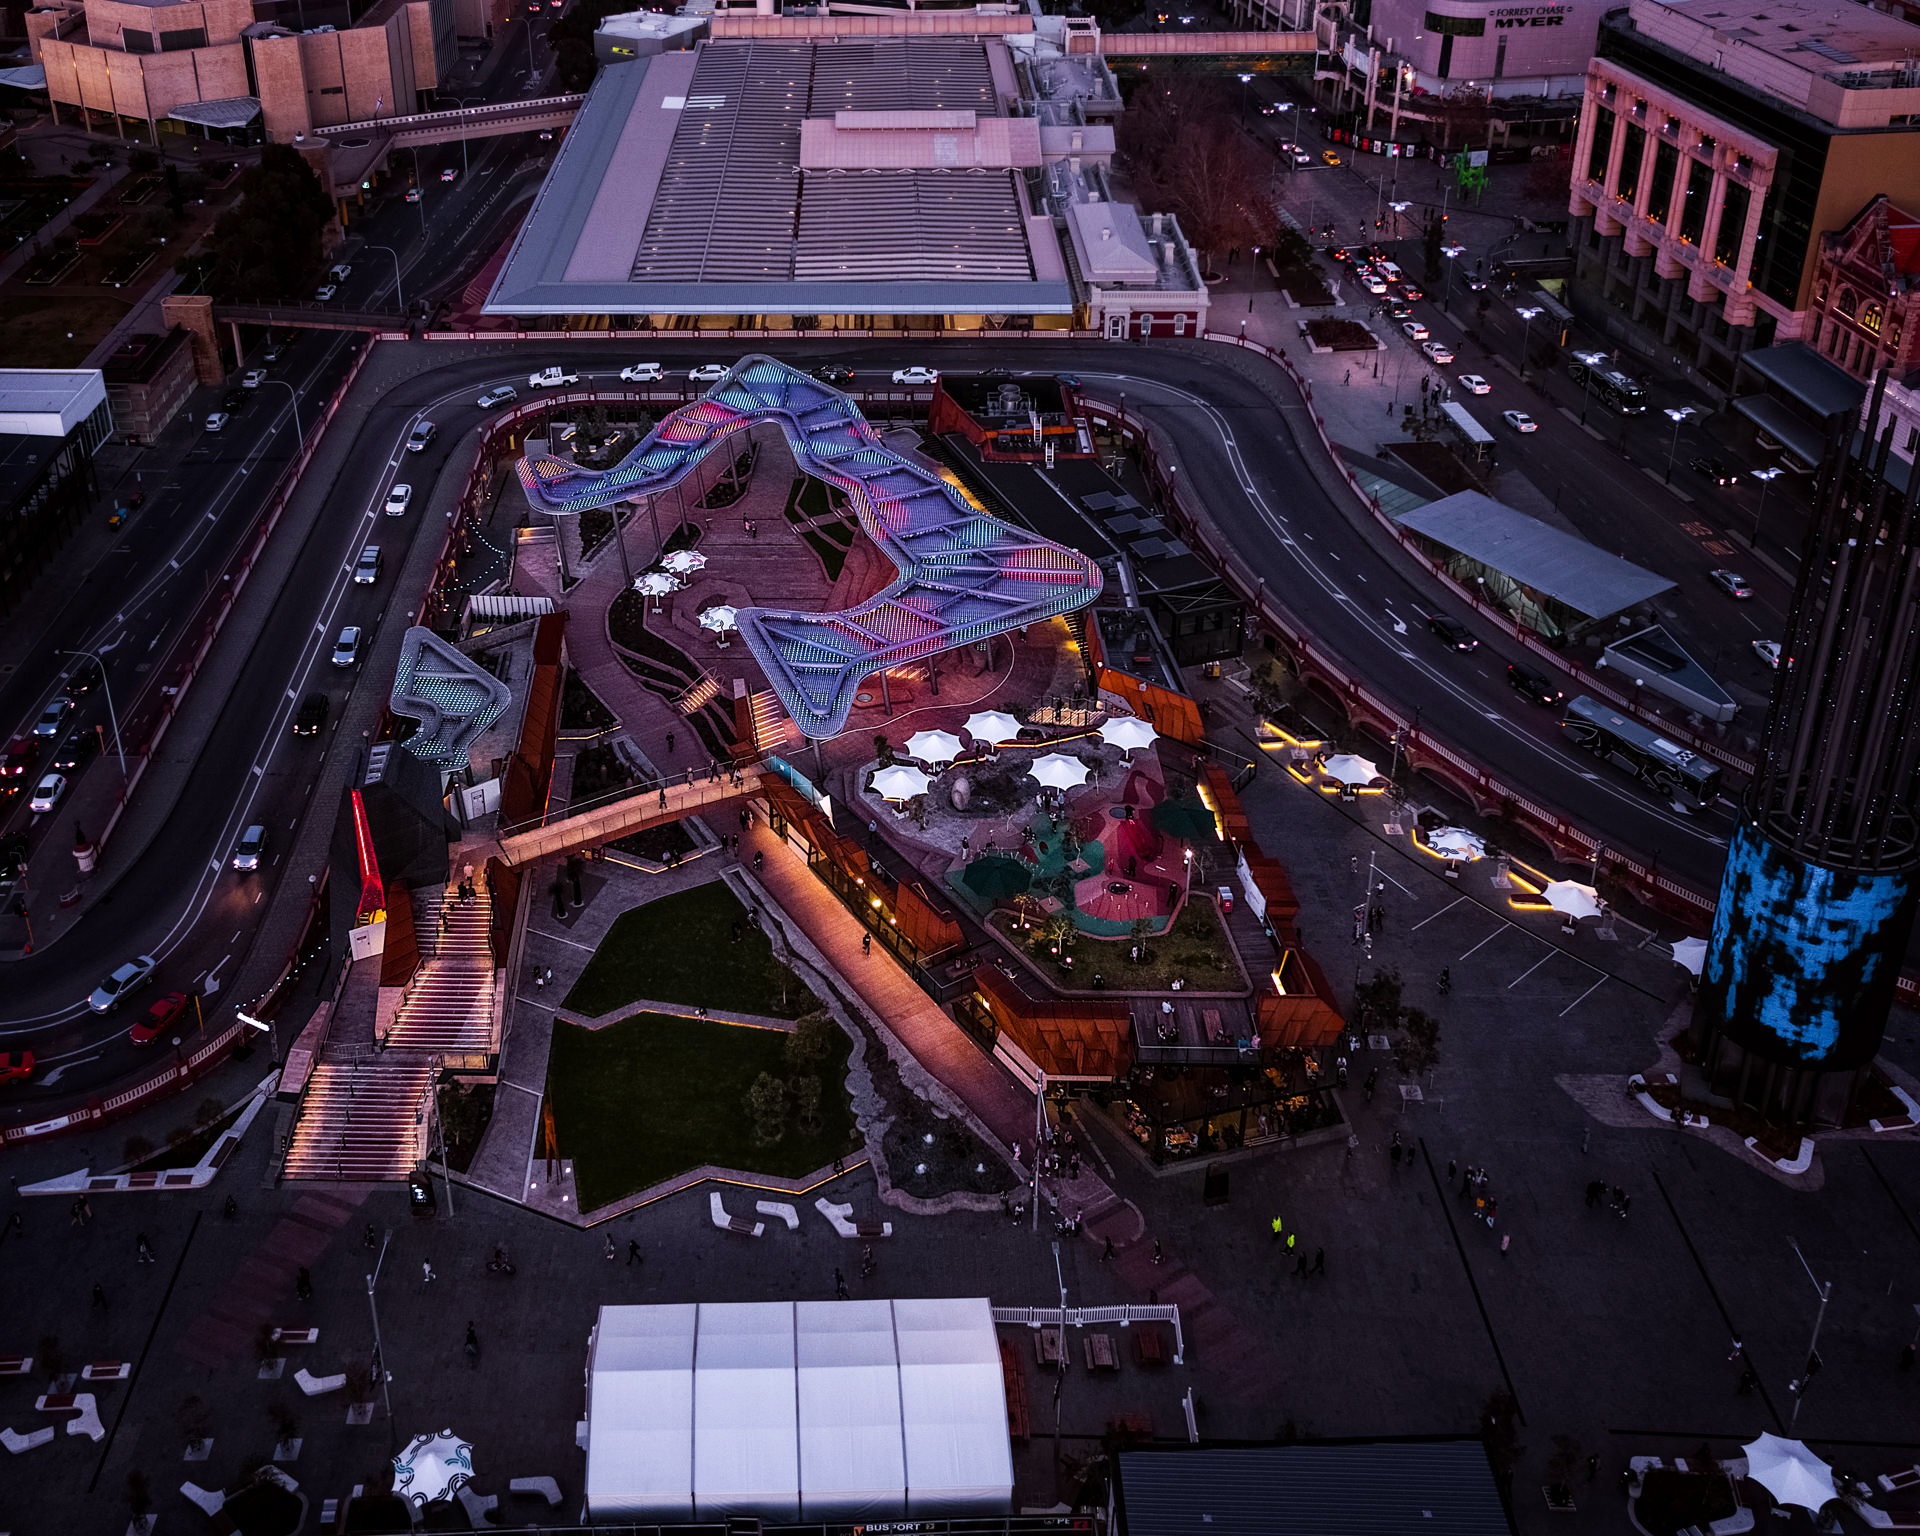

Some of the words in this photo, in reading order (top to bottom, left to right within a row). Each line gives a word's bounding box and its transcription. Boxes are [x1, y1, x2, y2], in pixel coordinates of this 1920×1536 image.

[1497, 8, 1534, 16] FORREST
[1536, 6, 1565, 15] CHASE
[1495, 16, 1564, 28] MYER
